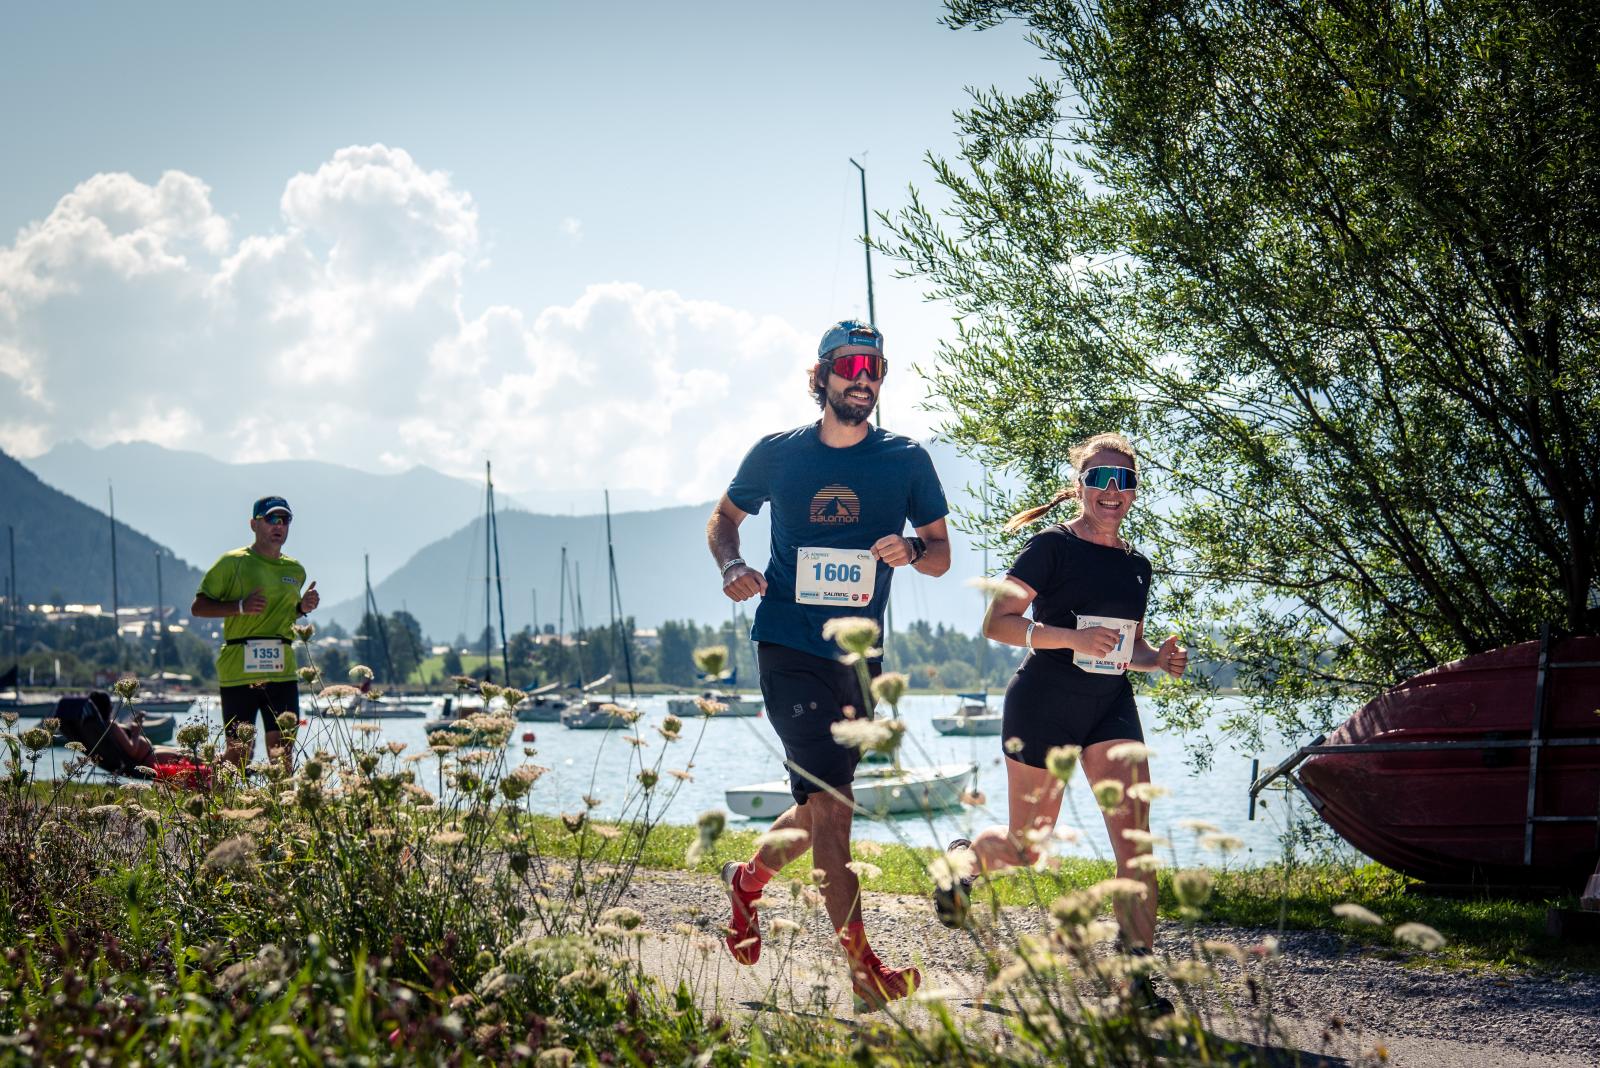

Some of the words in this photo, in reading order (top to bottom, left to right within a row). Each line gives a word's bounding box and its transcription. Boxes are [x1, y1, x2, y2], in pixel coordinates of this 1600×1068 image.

[810, 515, 859, 523] salomon
[813, 563, 861, 583] 1606
[252, 647, 280, 659] 1353
